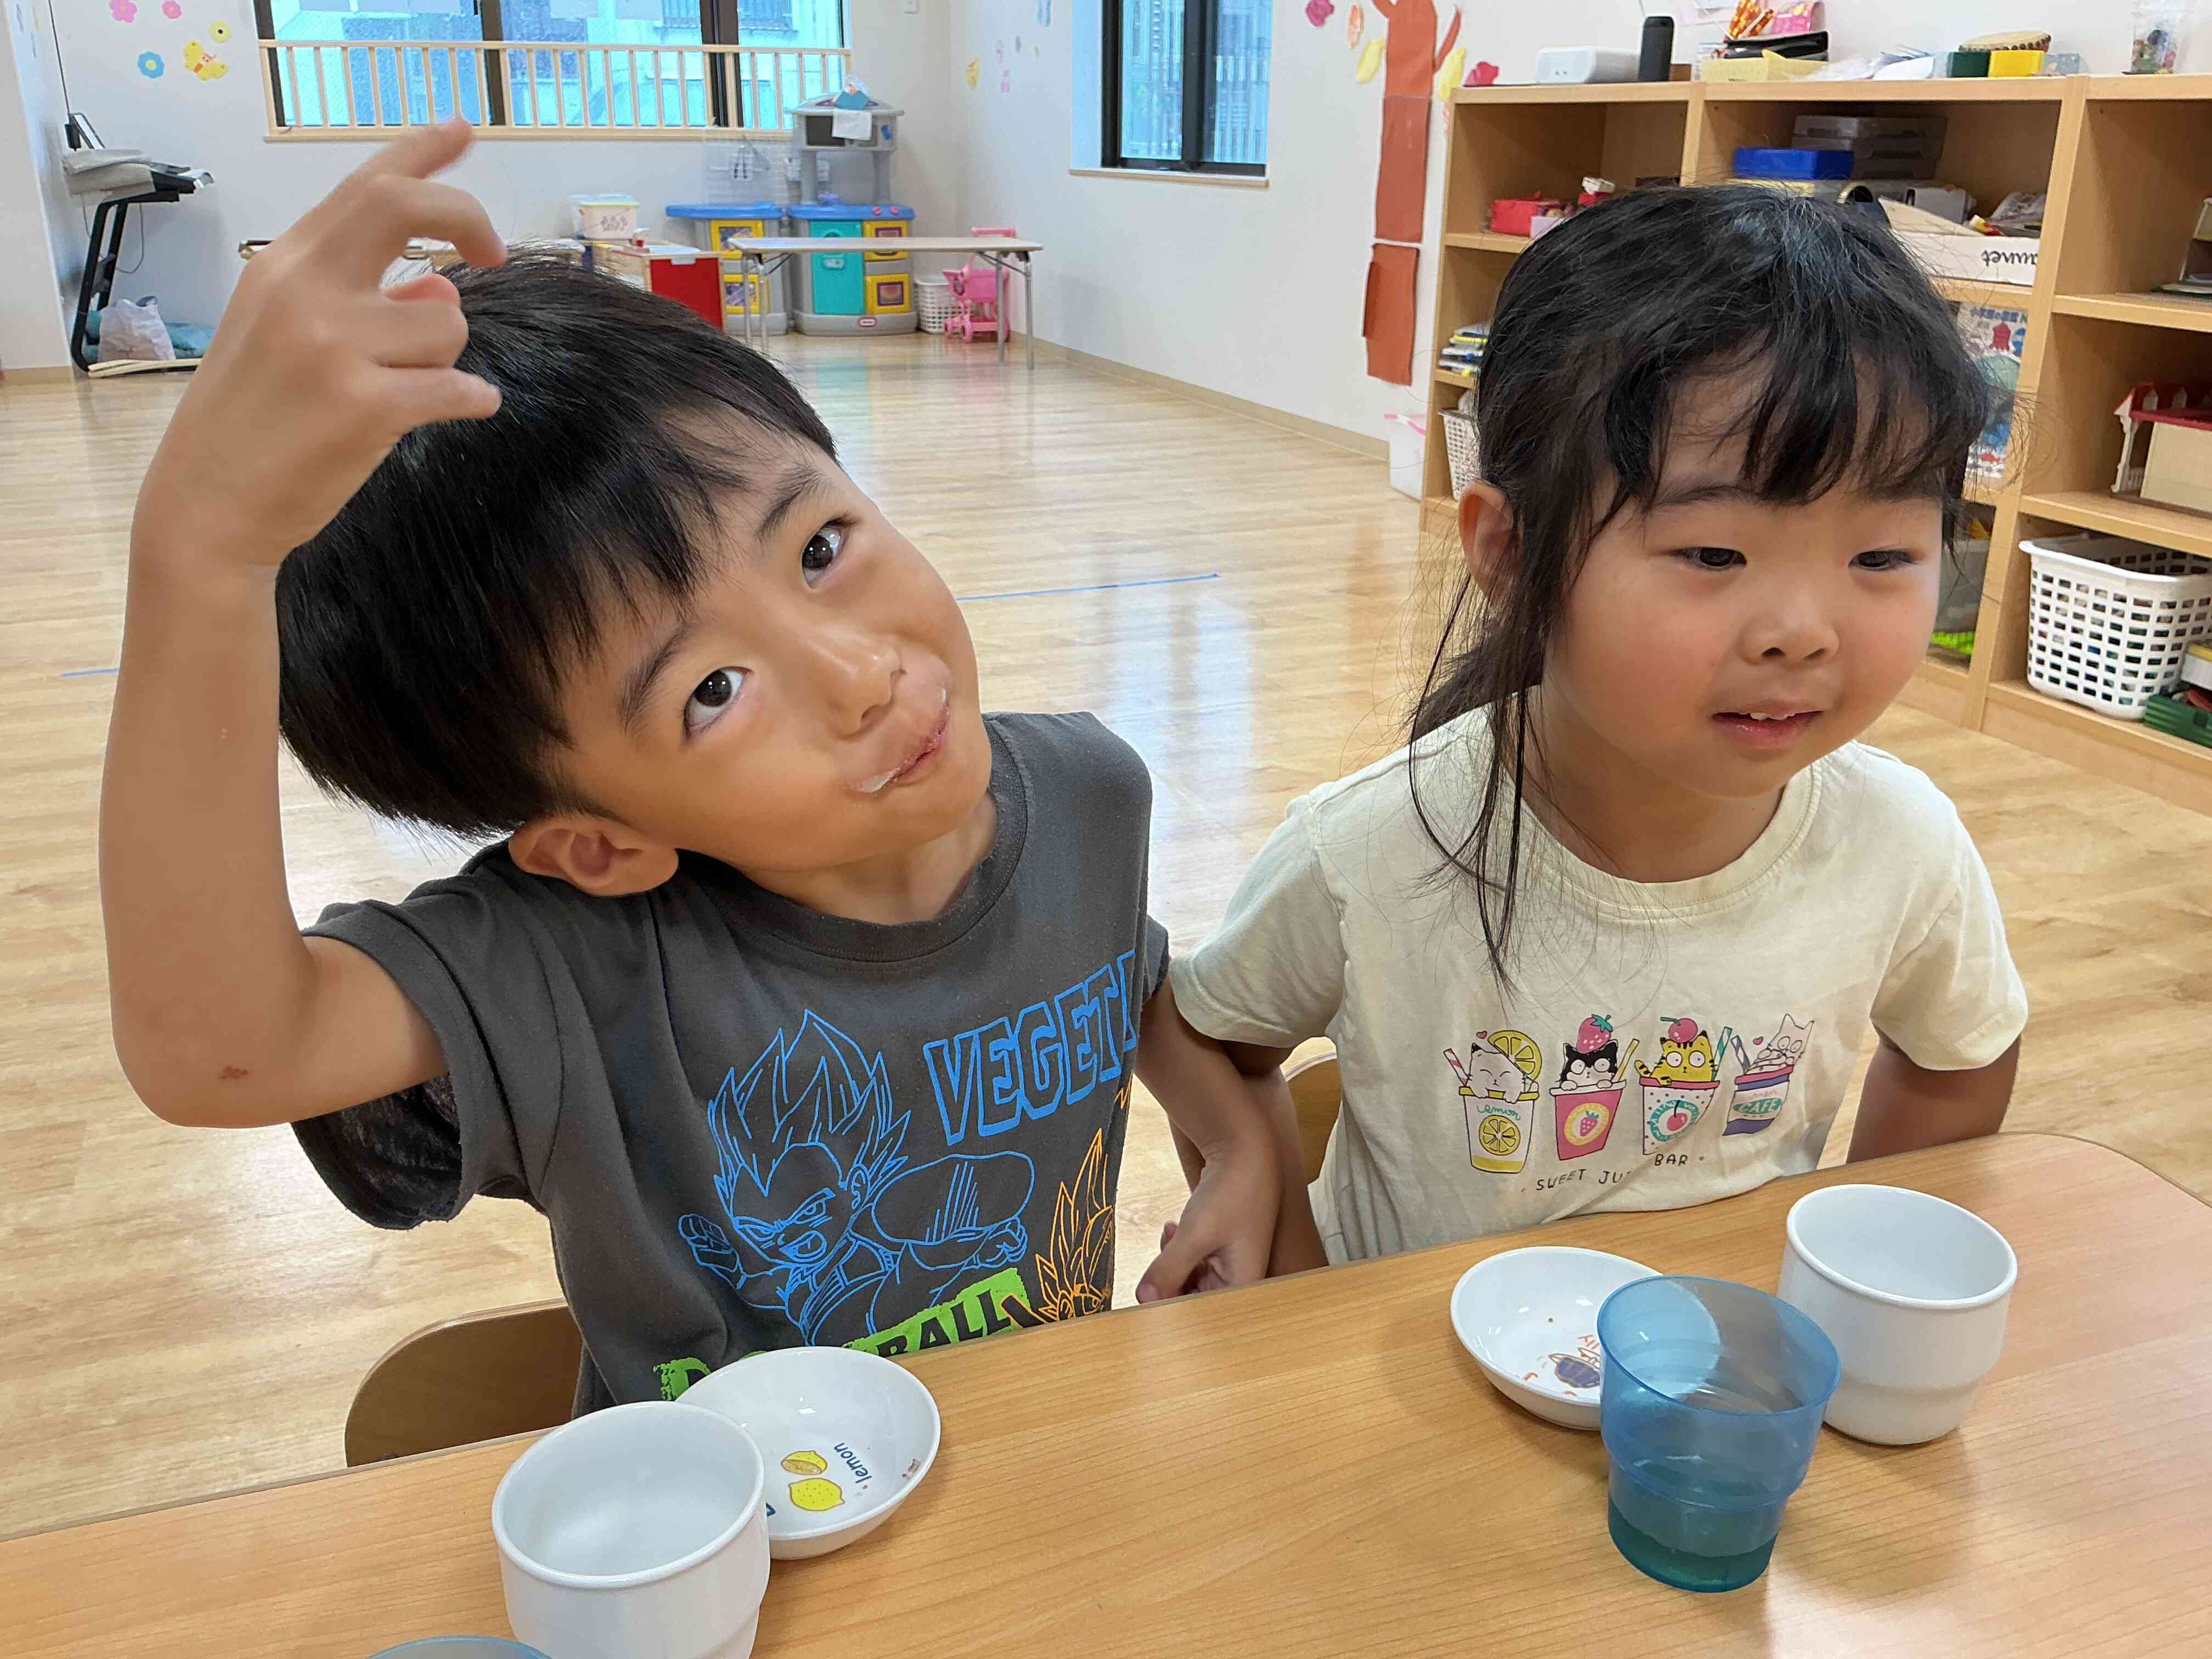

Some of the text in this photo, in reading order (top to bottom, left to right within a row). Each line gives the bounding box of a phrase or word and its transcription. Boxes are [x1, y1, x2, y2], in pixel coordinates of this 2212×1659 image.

[1536, 1154, 1689, 1191] SWEET JU BAR
[834, 1442, 872, 1483] lemon
